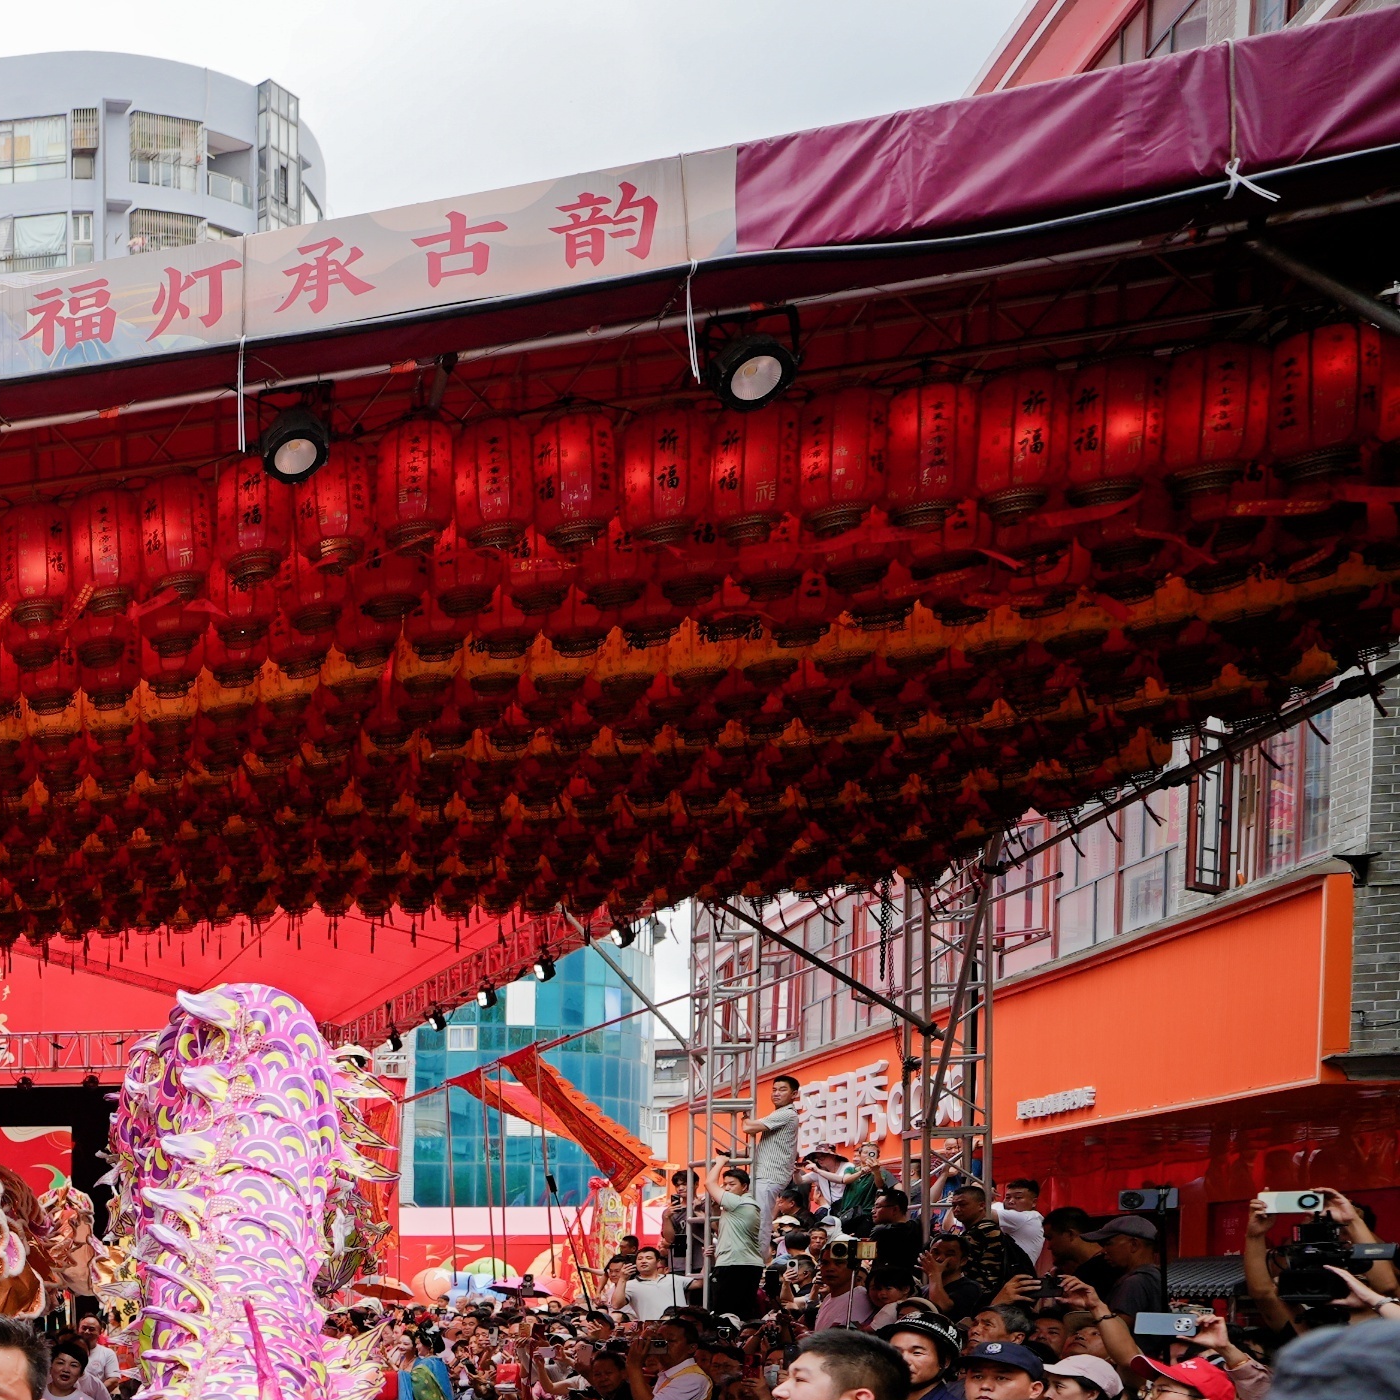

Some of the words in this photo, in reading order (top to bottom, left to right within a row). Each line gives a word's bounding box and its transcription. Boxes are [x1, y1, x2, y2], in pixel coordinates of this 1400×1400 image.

[20, 181, 659, 357] 福灯承古韵
[1362, 341, 1381, 414] 祈福
[869, 411, 887, 476] 祈福
[1016, 388, 1049, 456] 祈福
[1073, 387, 1101, 456] 祈福
[536, 443, 558, 502] 祈福
[656, 427, 682, 491] 祈福
[718, 429, 743, 493] 祈福
[144, 498, 161, 556] 祈福
[243, 472, 263, 526] 祈福
[49, 519, 66, 574] 祈福
